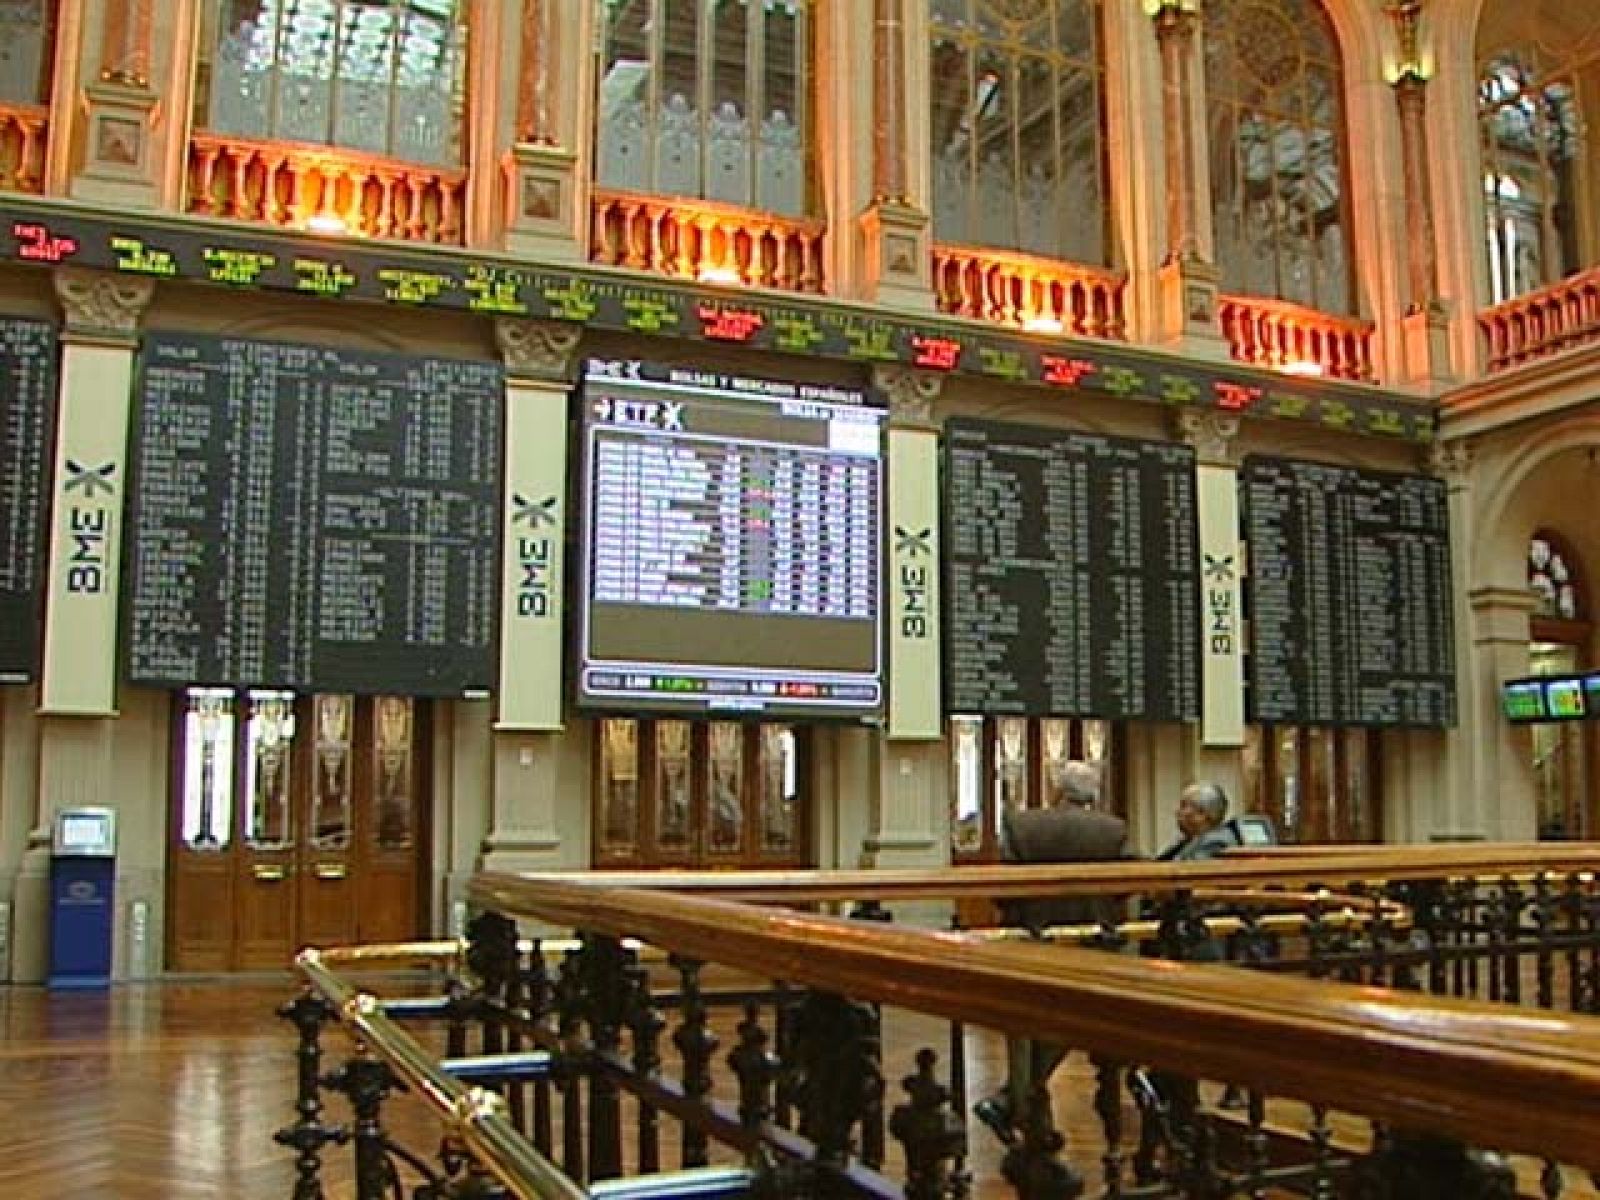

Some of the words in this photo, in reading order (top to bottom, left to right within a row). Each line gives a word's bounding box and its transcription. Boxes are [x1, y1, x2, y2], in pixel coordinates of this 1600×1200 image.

[69, 507, 104, 593] BME
[518, 536, 549, 618] BME
[901, 564, 927, 639] BME
[1210, 588, 1231, 654] BME
